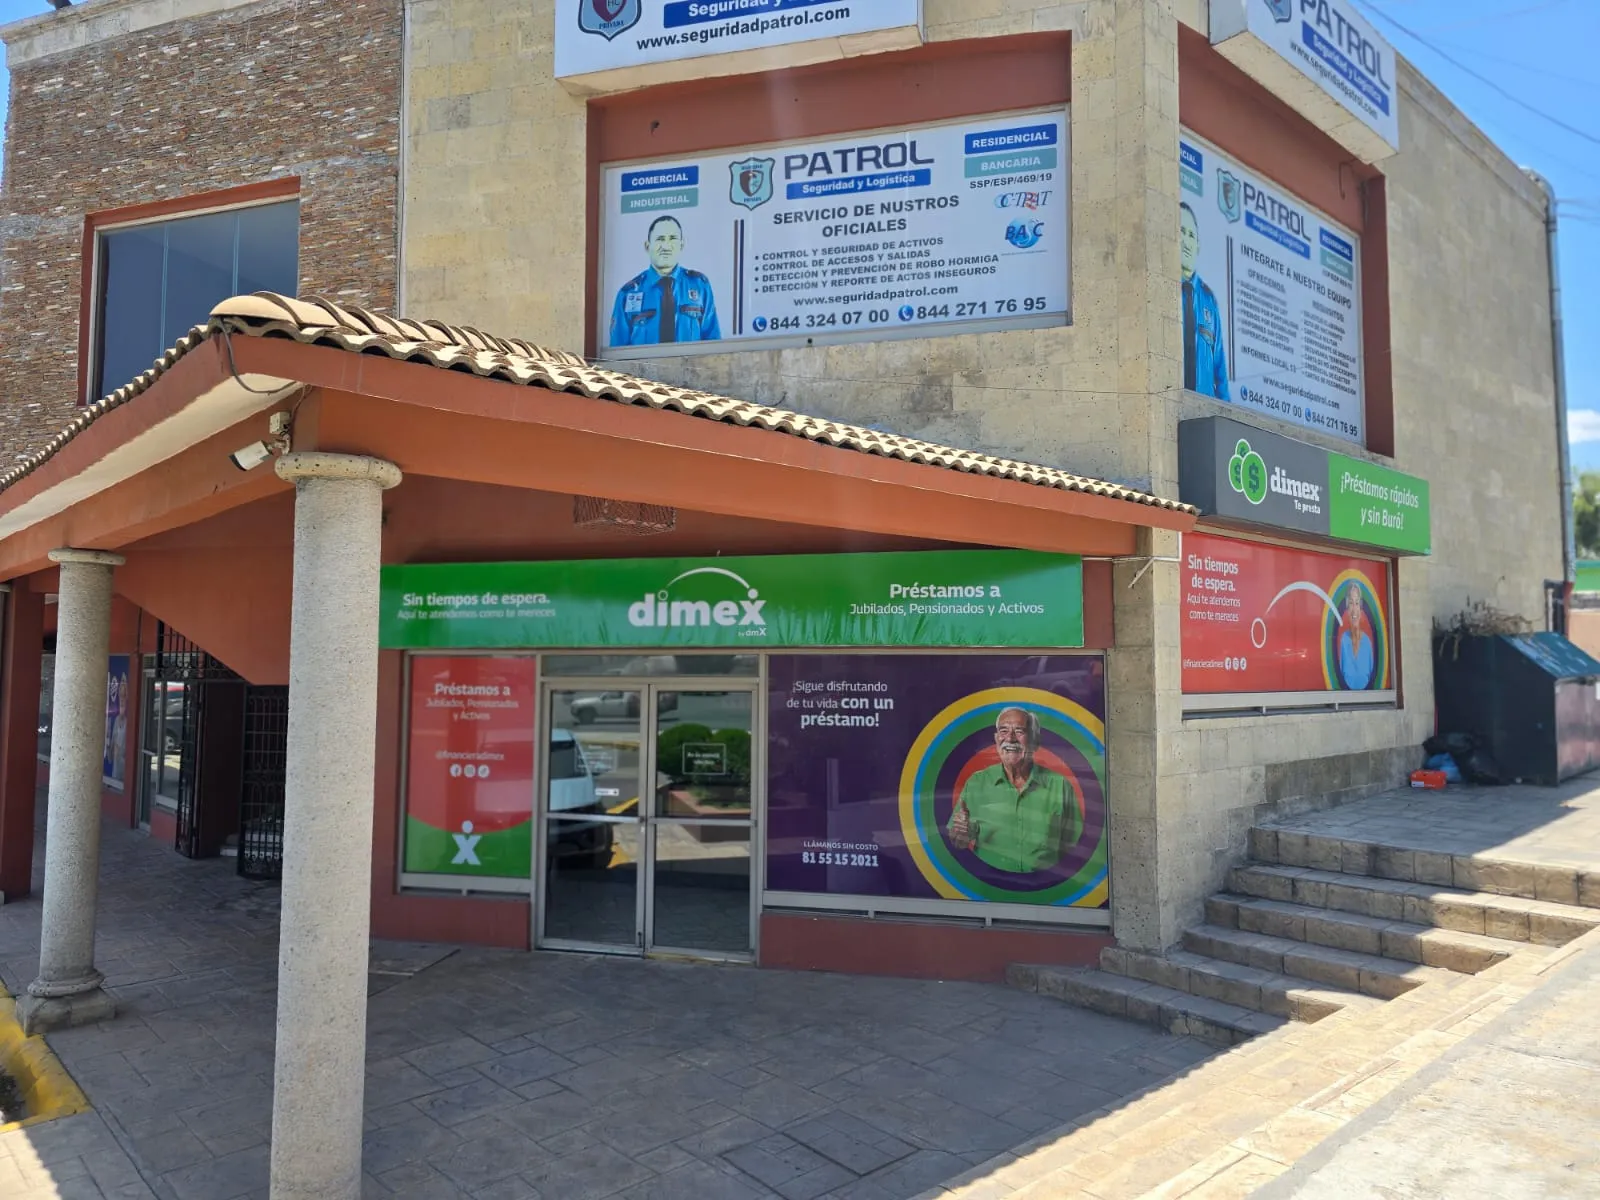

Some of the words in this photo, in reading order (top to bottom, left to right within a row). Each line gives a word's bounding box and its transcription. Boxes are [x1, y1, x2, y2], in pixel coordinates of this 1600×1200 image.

[637, 7, 850, 50] www.seguridadpatrol.com
[972, 131, 1050, 148] RESIDENCIAL
[784, 140, 934, 180] PATROL
[980, 156, 1041, 172] BANCARIA
[631, 172, 688, 186] COMERCIAL
[802, 179, 855, 194] Seguridad
[857, 179, 864, 190] y
[969, 172, 1052, 189] SSP/ESP/469/19
[630, 194, 690, 208] INDUSTRIAL
[773, 206, 848, 225] SERVICIO
[854, 204, 875, 217] DE
[880, 195, 960, 214] NUSTROS
[1243, 181, 1312, 242] PATROL
[822, 218, 907, 238] OFICIALES
[762, 250, 808, 261] CONTROL
[821, 242, 879, 256] SEGURIDAD
[882, 241, 896, 250] DE
[900, 237, 944, 248] ACTIVOS
[762, 260, 808, 272] CONTROL
[812, 258, 824, 267] DE
[828, 254, 874, 266] ACCESOS
[888, 250, 930, 260] SALIDAS
[762, 270, 818, 282] DETECCIÓN
[822, 269, 828, 277] Y
[830, 262, 896, 276] PREVENCIÓN
[900, 261, 912, 270] DE
[916, 259, 945, 269] ROBO
[948, 254, 999, 266] HORMIGA
[762, 280, 818, 294] DETECCIÓN
[822, 280, 828, 288] Y
[831, 276, 876, 288] REPORTE
[880, 274, 894, 282] DE
[896, 270, 930, 282] ACTOS
[934, 266, 996, 279] INSEGUROS
[1240, 244, 1284, 276] INTEGRATE
[1286, 268, 1292, 279] A
[1293, 270, 1326, 296] NUESTRO
[1328, 288, 1352, 310] EQUIPO
[794, 286, 958, 306] www.seguridadpatrol.com
[917, 304, 950, 320] 844
[955, 301, 987, 316] 271
[994, 299, 1018, 314] 76
[1024, 296, 1046, 311] 95
[770, 316, 800, 330] 844
[806, 312, 836, 328] 324
[842, 311, 862, 325] 07
[868, 309, 890, 323] 00
[1248, 390, 1264, 406] 844
[1266, 396, 1280, 411] 324
[1282, 400, 1291, 414] 07
[1293, 405, 1302, 418] 00
[1312, 412, 1325, 426] 844
[1326, 416, 1338, 430] 271
[1349, 424, 1358, 437] 95
[1270, 466, 1320, 502] dimex
[1340, 472, 1388, 501] ¡Préstamos
[1390, 485, 1419, 508] rápidos
[1294, 500, 1302, 510] Te
[1360, 507, 1367, 527] y
[1368, 506, 1380, 525] sin
[1382, 509, 1404, 530] Buró!
[1188, 554, 1202, 570] Sin
[1204, 556, 1239, 576] tiempos
[890, 582, 984, 599] Préstamos
[990, 584, 1002, 598] a
[1192, 573, 1203, 588] de
[1204, 578, 1236, 594] espera.
[403, 592, 424, 606] Sin
[426, 592, 479, 608] tiempos
[481, 592, 498, 604] de
[502, 593, 551, 607] espera.
[628, 589, 767, 627] dimex
[850, 602, 907, 616] Jubilados,
[910, 602, 984, 615] Pensionados
[988, 604, 996, 616] y
[998, 602, 1045, 614] Activos
[1202, 594, 1208, 604] te
[434, 682, 500, 696] Préstamos
[502, 686, 511, 696] a
[792, 680, 824, 694] ¡Sigue
[826, 680, 888, 692] disfrutando
[786, 697, 800, 709] de
[802, 698, 814, 709] tu
[816, 698, 838, 709] vida
[840, 698, 870, 710] con
[873, 698, 894, 710] un
[800, 711, 880, 729] préstamo!
[802, 852, 816, 864] 81
[818, 852, 832, 864] 55
[835, 853, 848, 865] 15
[850, 854, 880, 867] 2021
